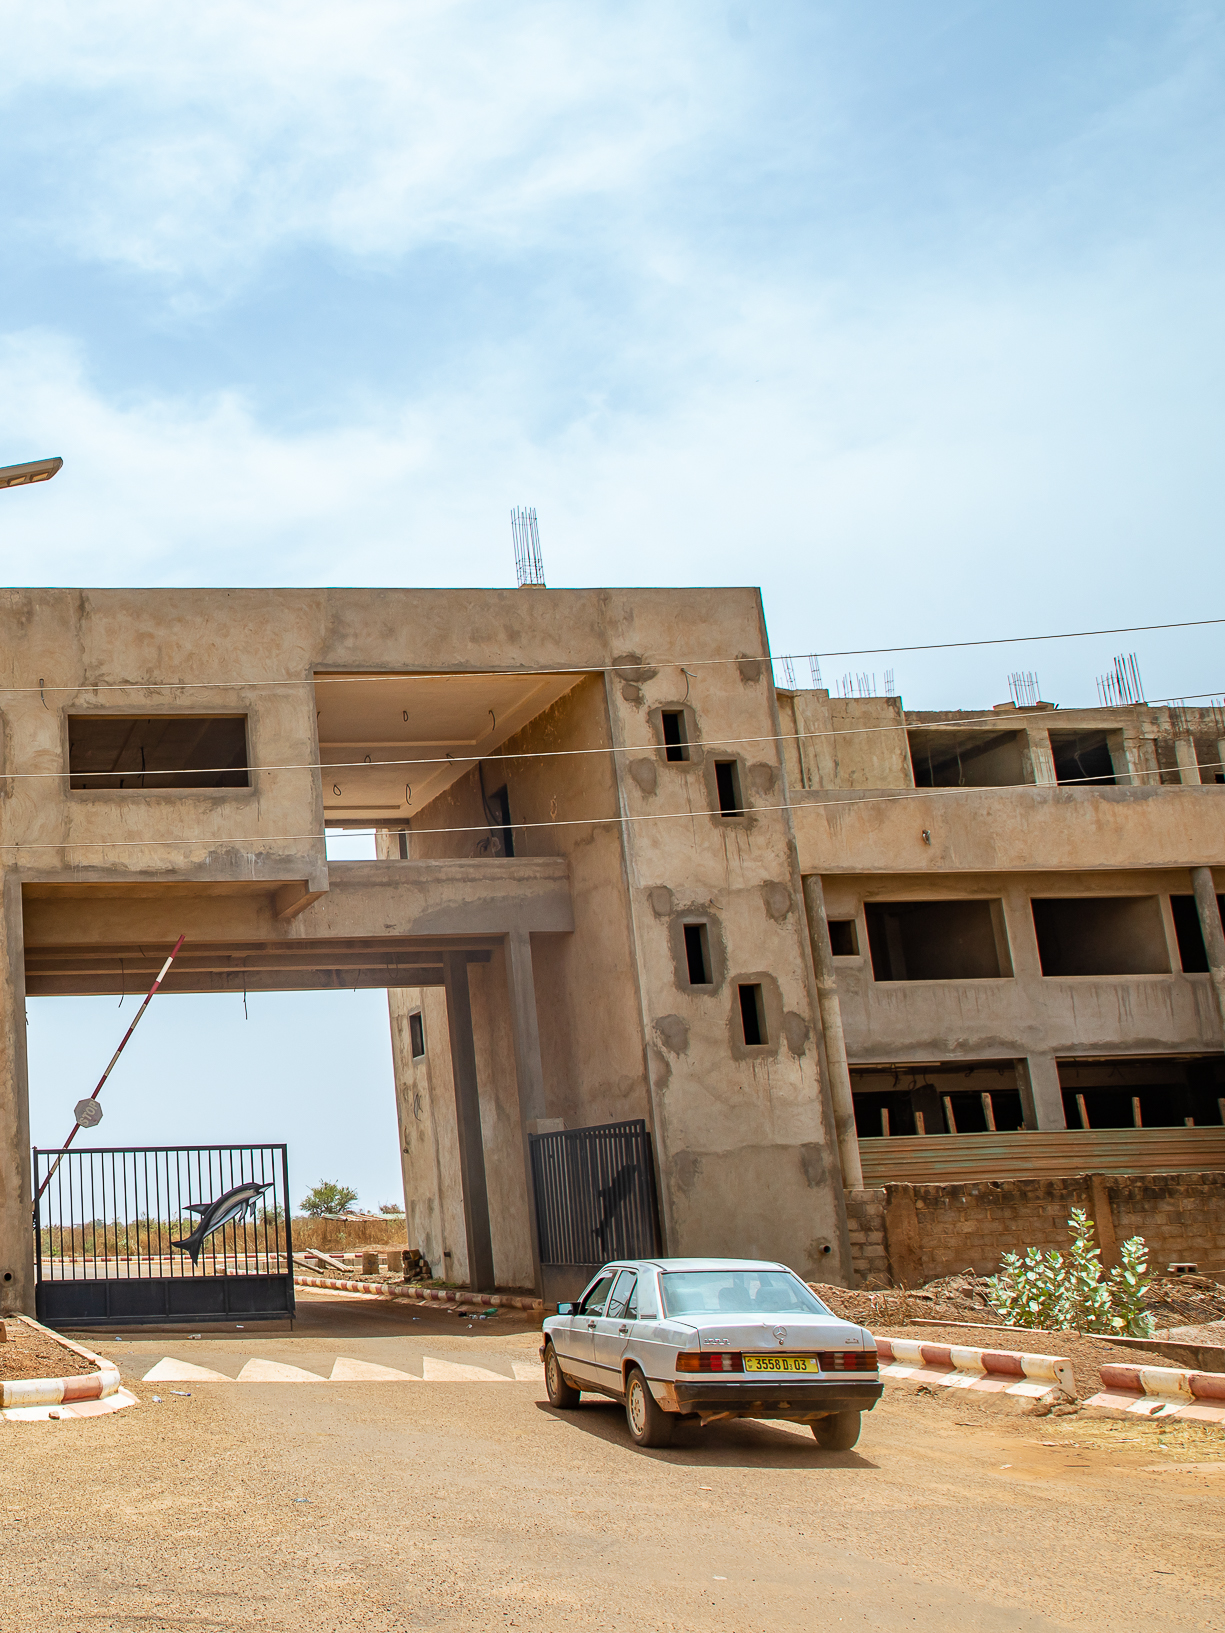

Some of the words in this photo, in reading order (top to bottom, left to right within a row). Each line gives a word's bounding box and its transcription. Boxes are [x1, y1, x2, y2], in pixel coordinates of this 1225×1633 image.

[79, 1101, 98, 1126] STOP
[755, 1358, 781, 1370] 3558
[794, 1359, 807, 1371] 03
